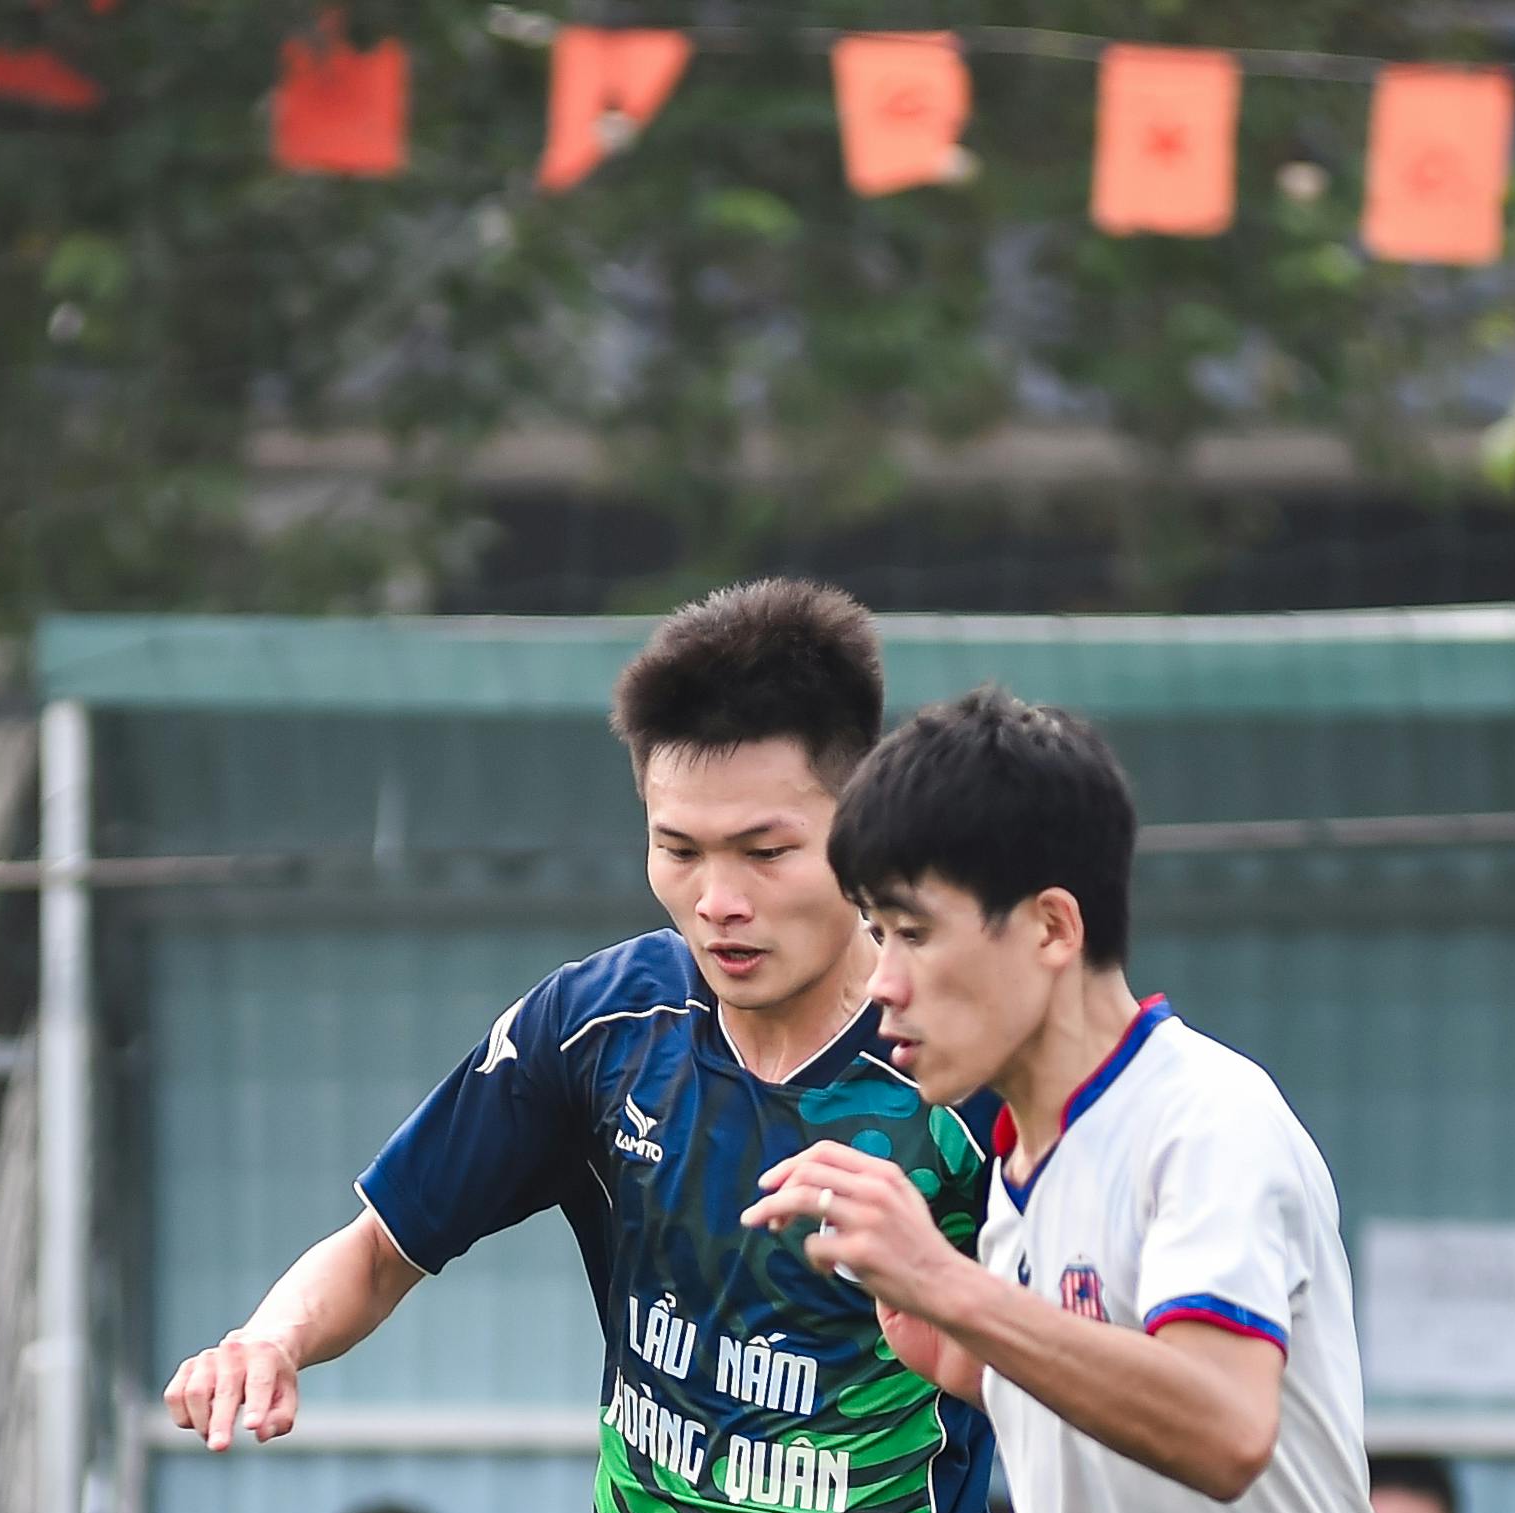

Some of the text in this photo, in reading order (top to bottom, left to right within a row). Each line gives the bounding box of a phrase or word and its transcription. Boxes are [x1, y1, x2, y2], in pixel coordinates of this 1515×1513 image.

[629, 1292, 818, 1416] LẨU NẤM
[724, 1436, 850, 1513] QUÂN
